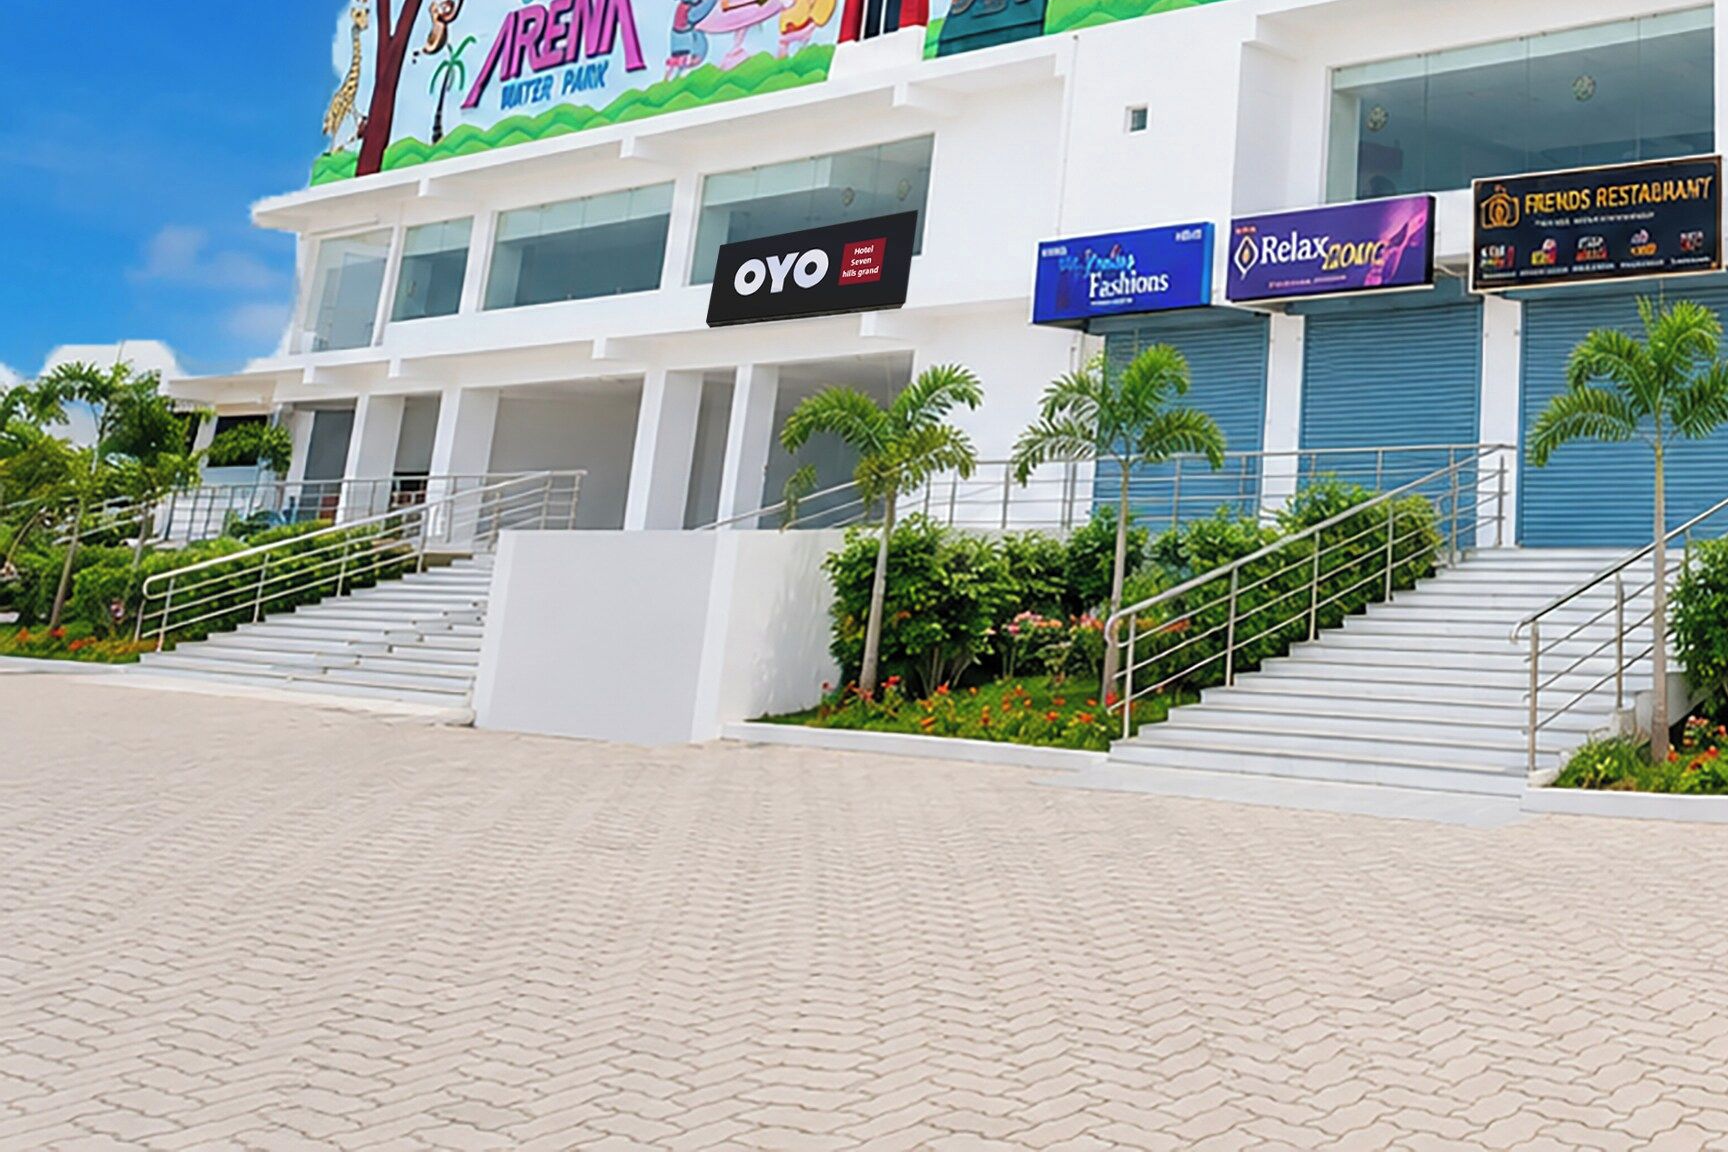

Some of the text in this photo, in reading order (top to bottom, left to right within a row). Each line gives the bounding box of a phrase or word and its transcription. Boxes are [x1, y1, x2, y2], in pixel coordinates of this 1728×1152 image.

[501, 60, 610, 110] WATER PARK
[850, 257, 872, 266] Seven
[854, 244, 874, 255] Hotel
[1260, 230, 1329, 264] Relax
[734, 248, 830, 296] OYO
[857, 265, 880, 278] grand
[1089, 269, 1169, 298] Fashions
